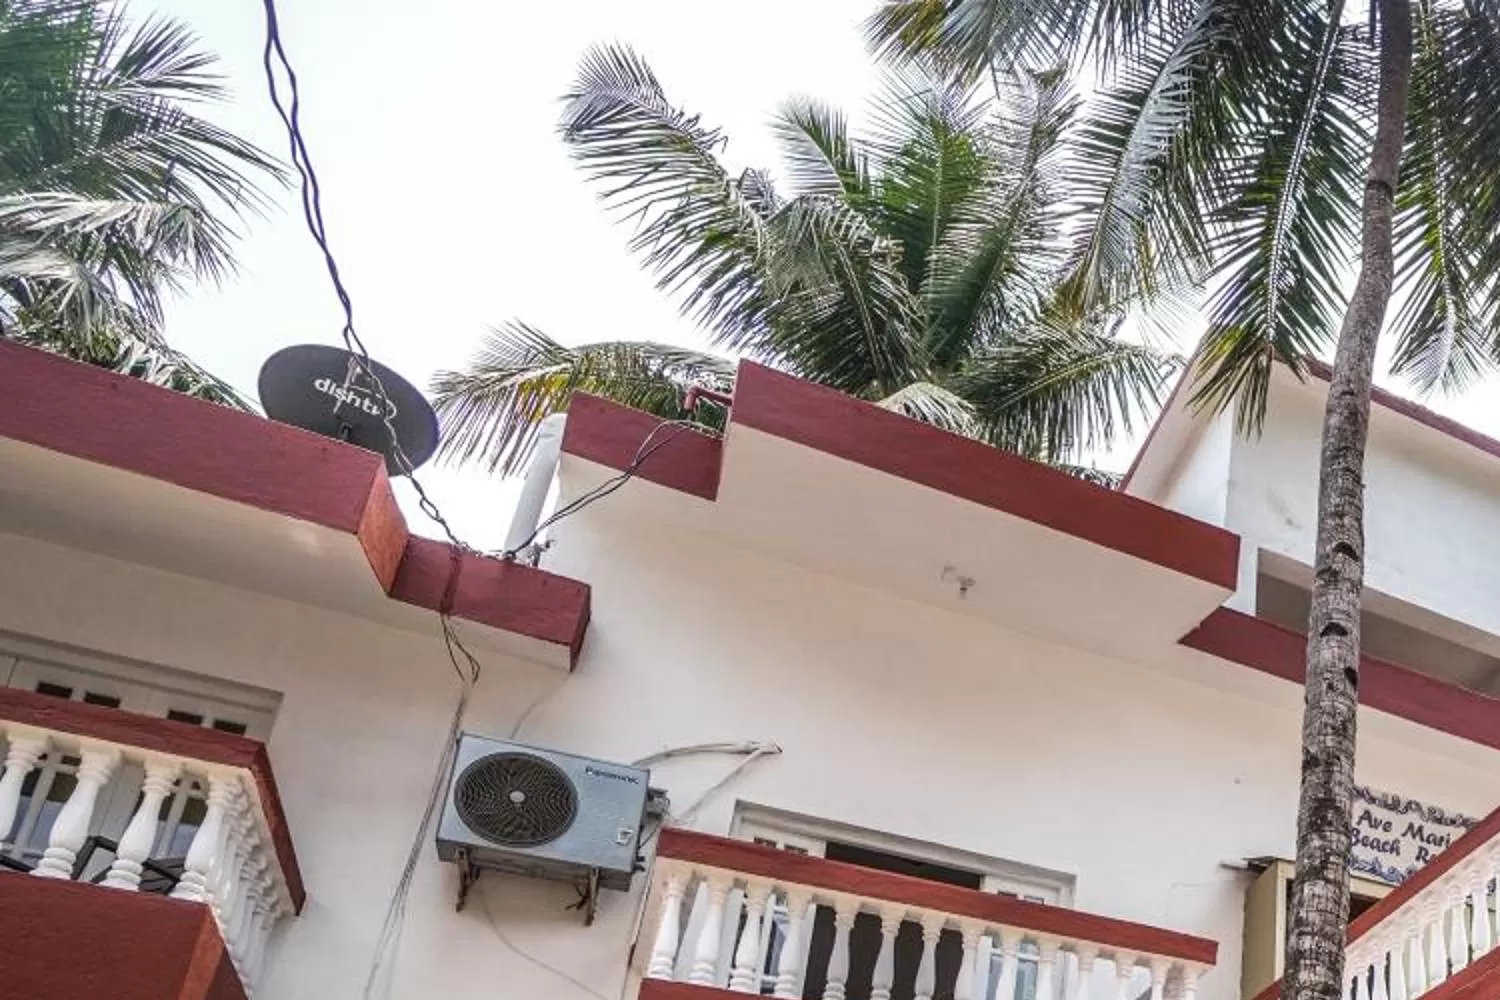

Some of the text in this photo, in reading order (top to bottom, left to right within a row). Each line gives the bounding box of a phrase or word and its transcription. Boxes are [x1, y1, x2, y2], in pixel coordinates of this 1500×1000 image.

[1350, 828, 1400, 856] Beach
[1356, 810, 1451, 849] Ave Mari
